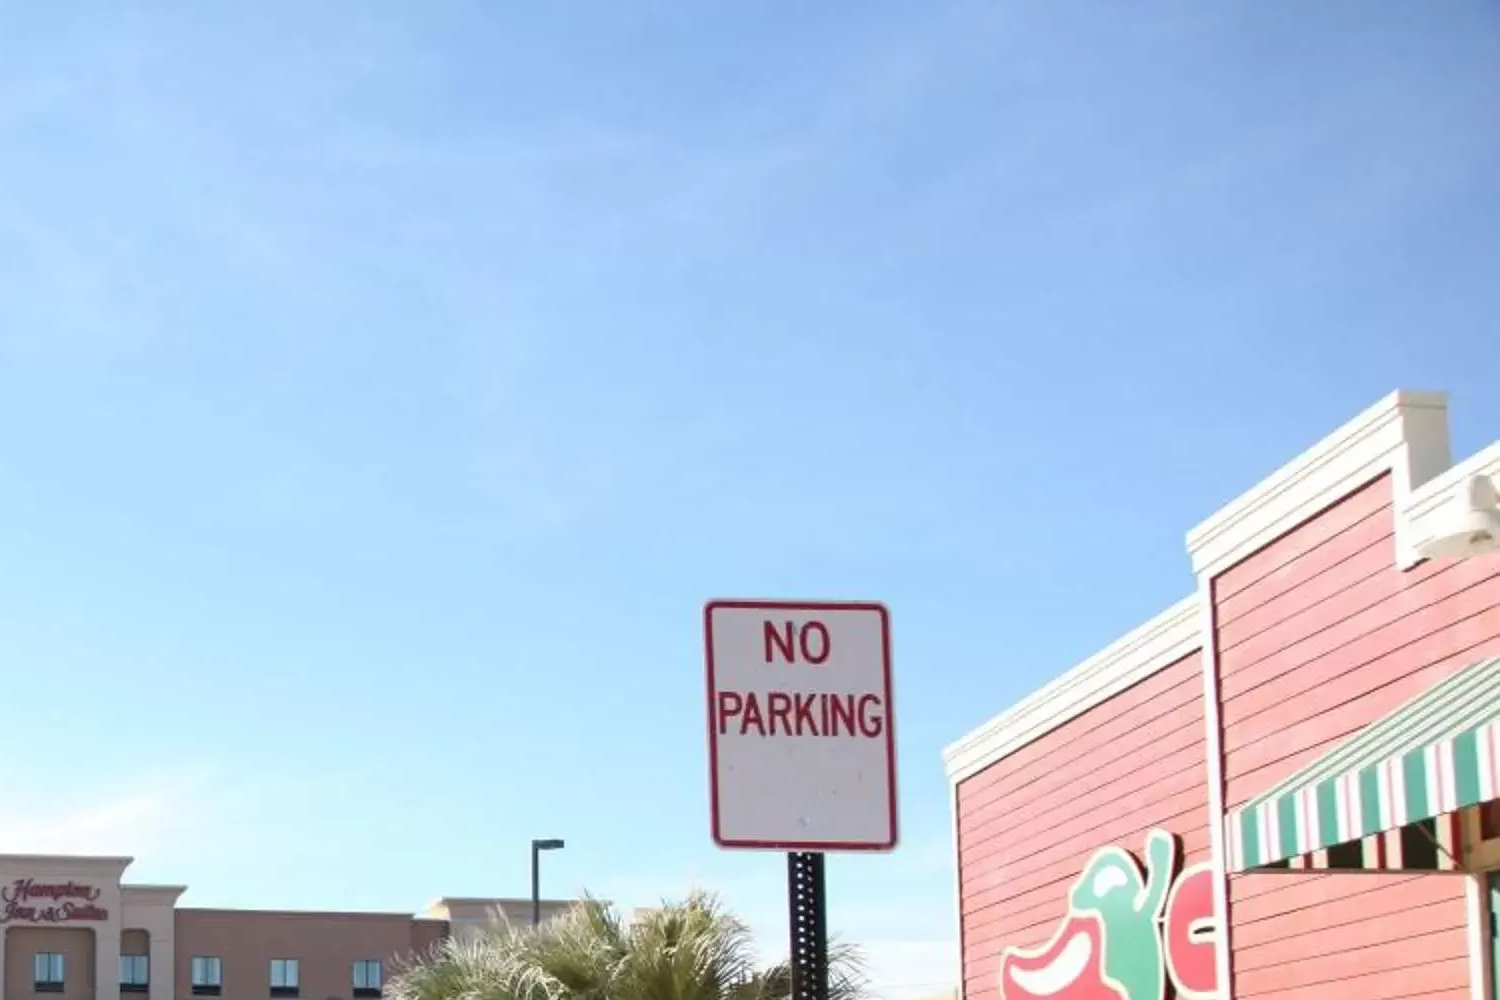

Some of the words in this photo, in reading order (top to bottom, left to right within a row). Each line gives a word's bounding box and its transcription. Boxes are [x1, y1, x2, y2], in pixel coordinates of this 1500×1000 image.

[763, 619, 831, 665] NO
[718, 690, 883, 738] PARKING
[2, 878, 100, 902] Hampton
